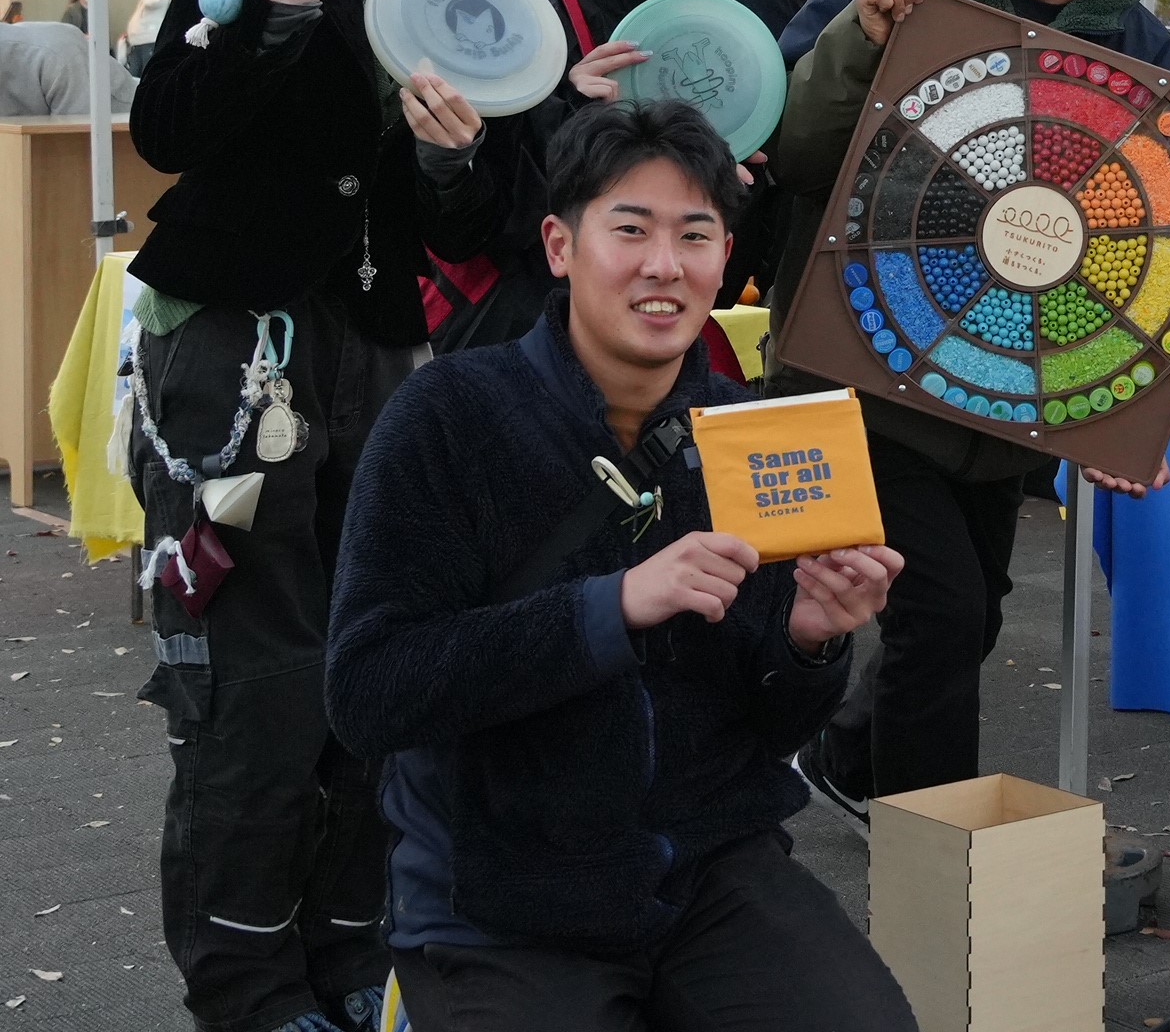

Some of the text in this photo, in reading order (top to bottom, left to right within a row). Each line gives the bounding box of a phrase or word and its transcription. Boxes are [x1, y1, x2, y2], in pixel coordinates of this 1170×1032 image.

[1004, 230, 1059, 252] TSUKURITO
[747, 447, 823, 470] Same
[751, 463, 832, 489] for all
[755, 485, 832, 508] sizes.
[758, 506, 805, 518] LACORME
